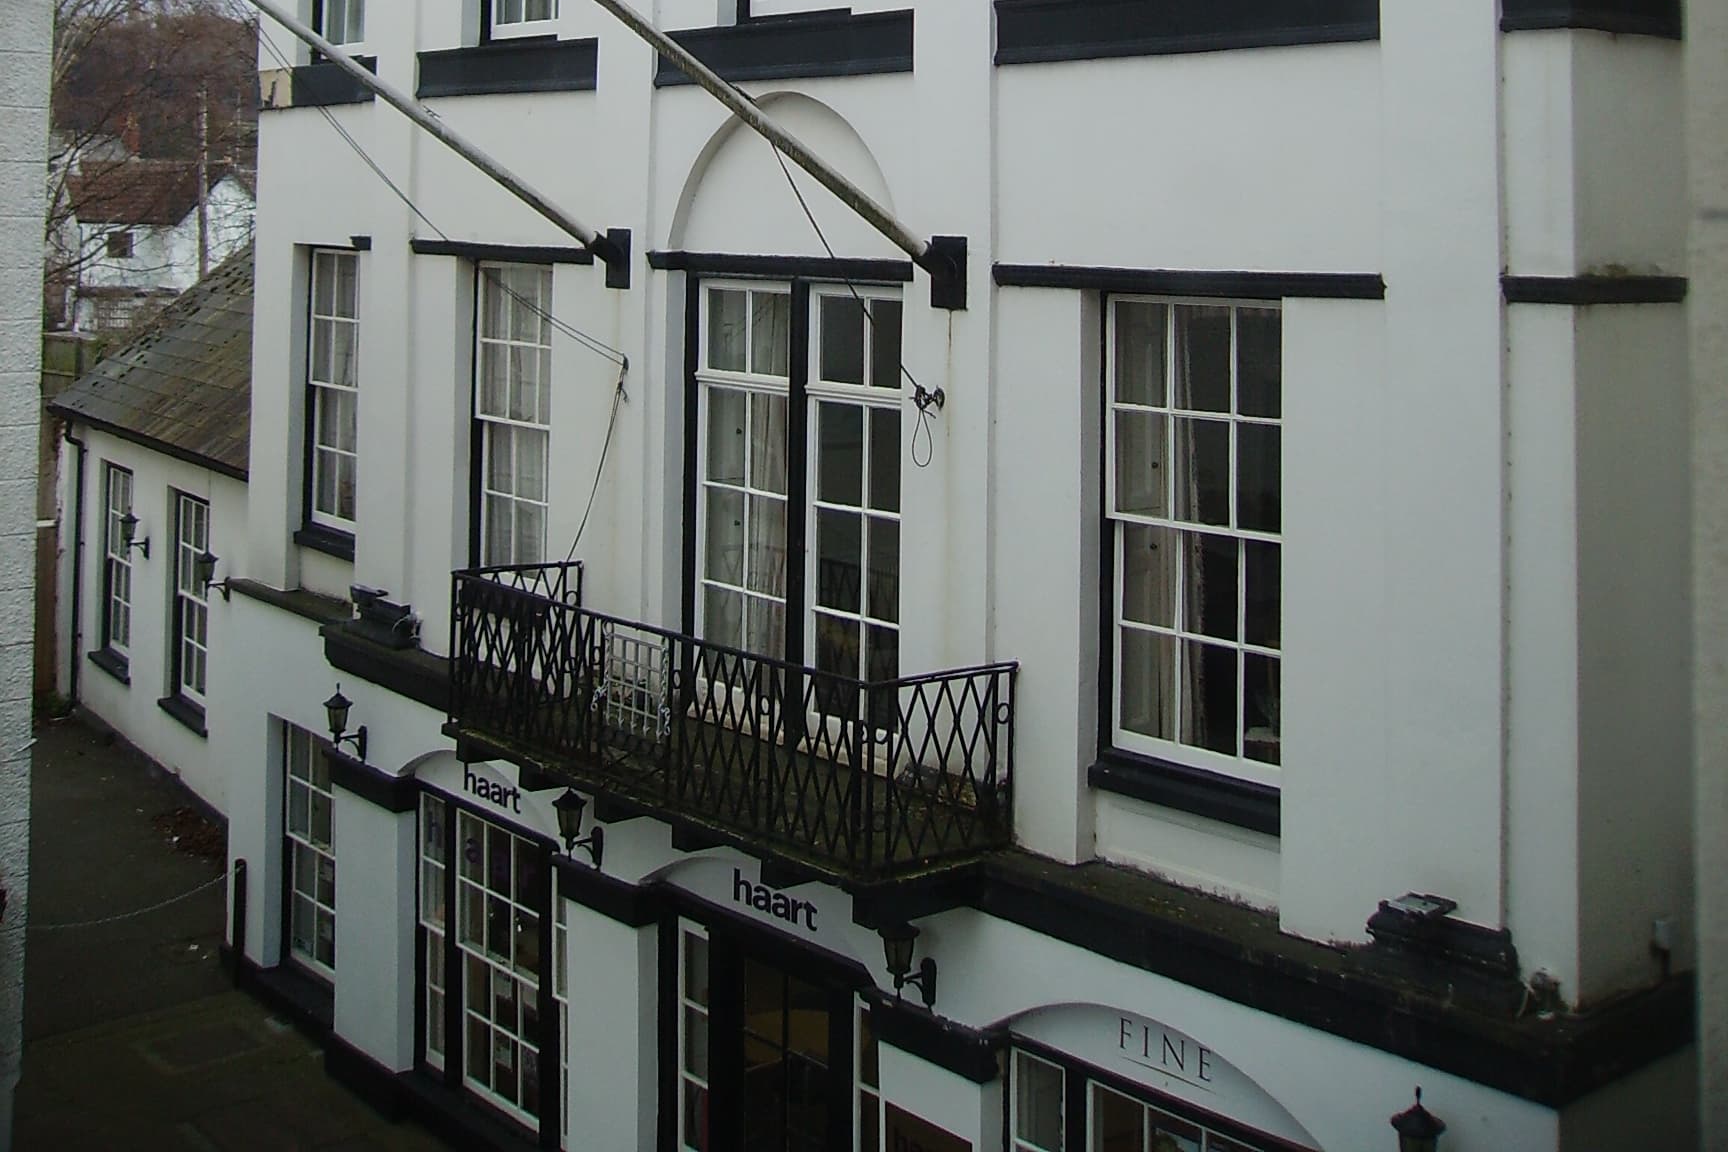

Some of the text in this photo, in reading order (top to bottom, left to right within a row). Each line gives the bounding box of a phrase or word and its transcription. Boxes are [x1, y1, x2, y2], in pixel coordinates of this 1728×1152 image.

[463, 762, 521, 815] haart
[733, 867, 818, 932] haart
[1119, 1016, 1212, 1083] FINE
